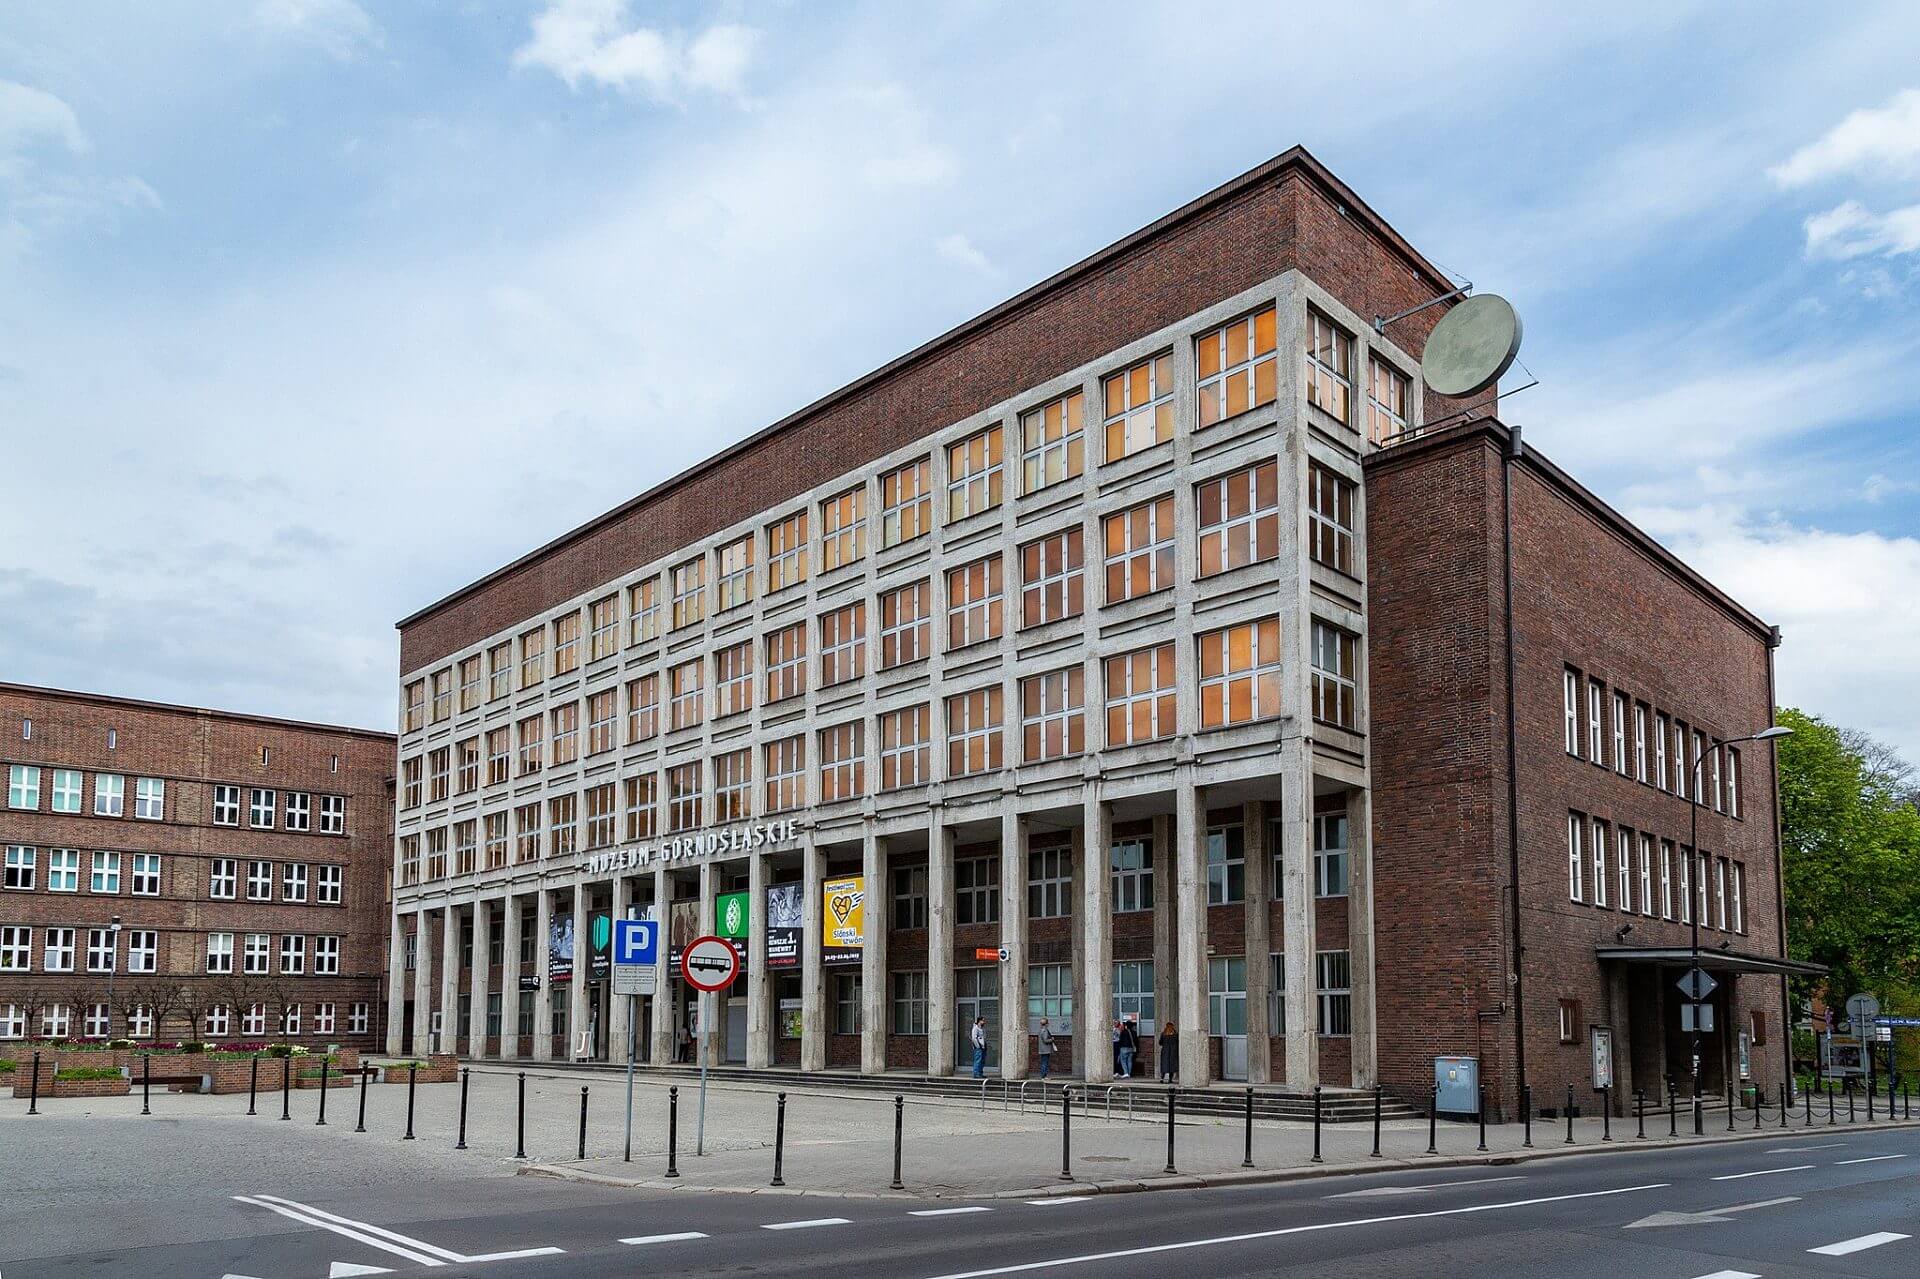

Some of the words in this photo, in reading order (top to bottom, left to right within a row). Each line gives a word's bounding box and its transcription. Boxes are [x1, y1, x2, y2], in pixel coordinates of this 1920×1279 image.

[589, 846, 649, 874] MUZEUM
[661, 818, 799, 862] GÓRNOŚLĄSKIE
[625, 925, 649, 959] P
